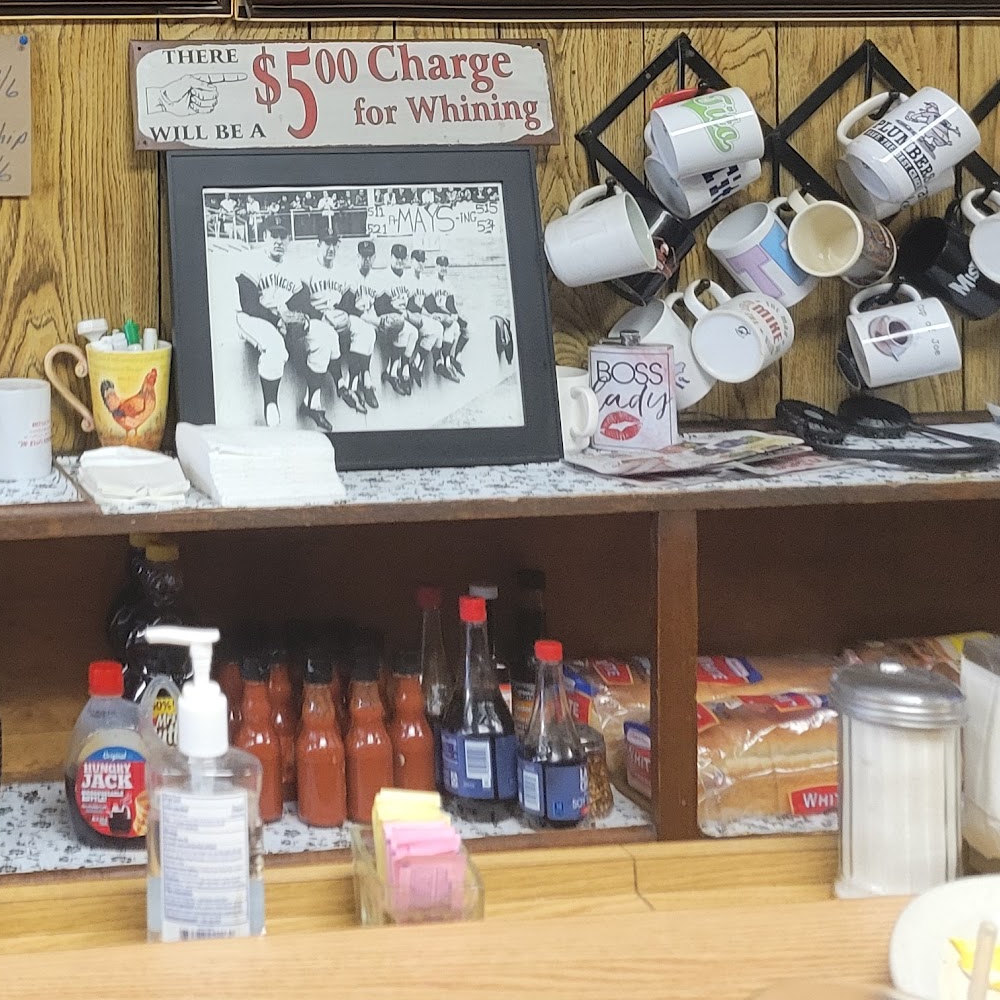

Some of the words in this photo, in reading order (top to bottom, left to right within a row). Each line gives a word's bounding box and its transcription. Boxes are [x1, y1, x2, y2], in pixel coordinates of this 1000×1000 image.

[162, 49, 239, 64] THERE
[367, 44, 513, 93] Charge
[354, 98, 398, 126] for
[406, 94, 538, 130] Whining
[150, 126, 208, 142] WILL
[216, 124, 244, 139] BE
[250, 123, 266, 138] A
[752, 303, 782, 344] MIKE
[597, 360, 663, 385] BOSS
[84, 762, 131, 774] HUNGRY
[82, 774, 133, 789] JACK
